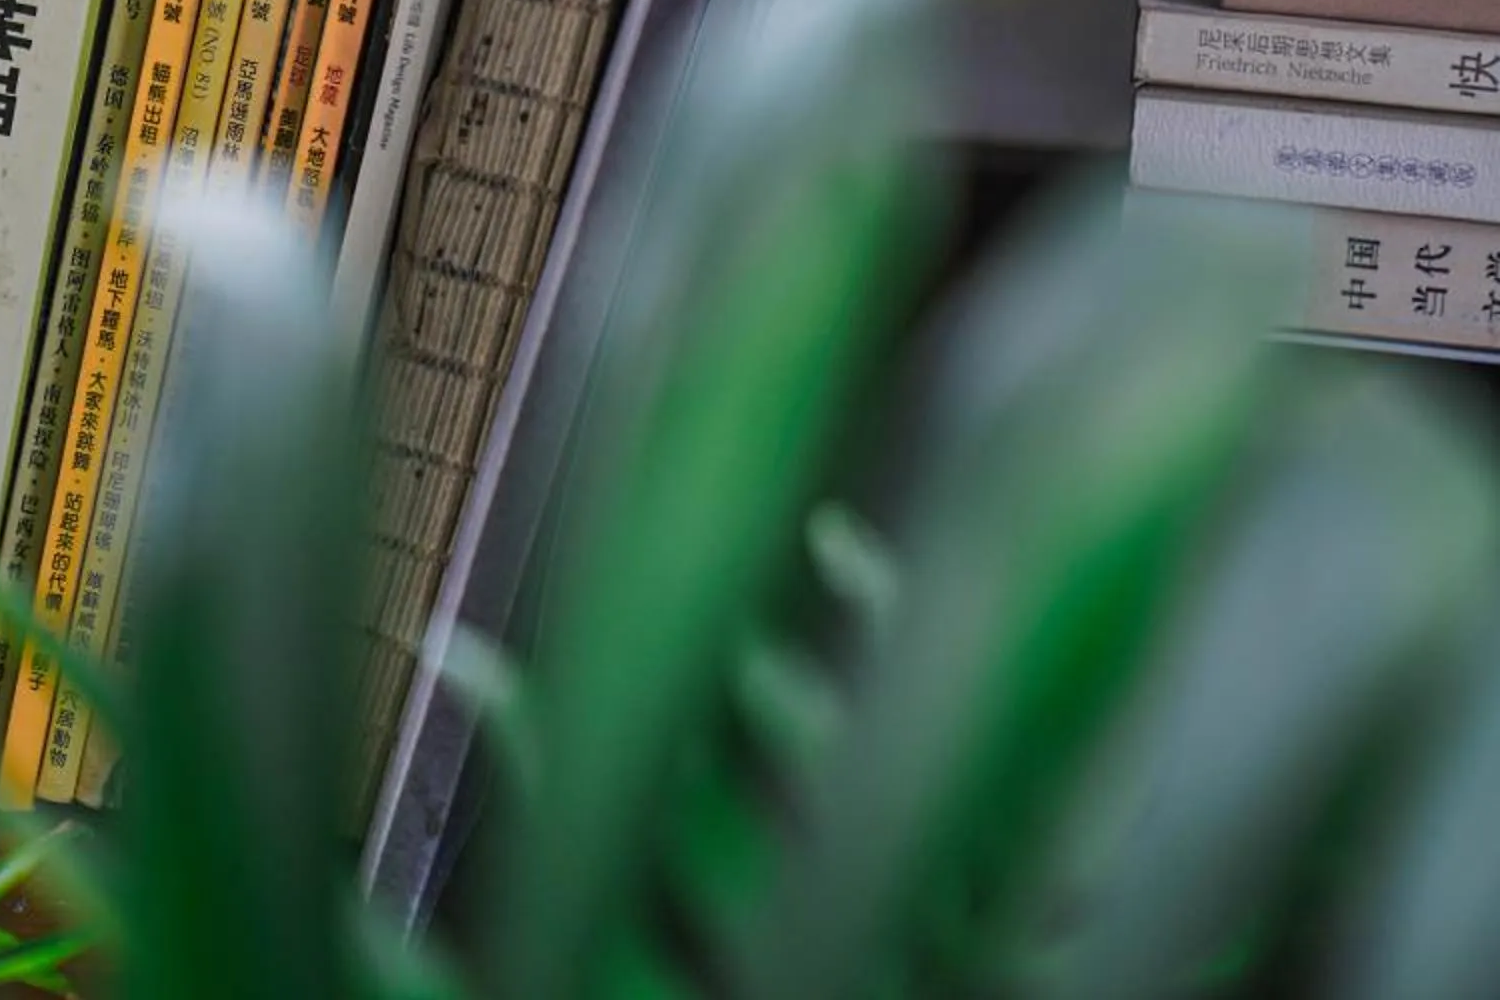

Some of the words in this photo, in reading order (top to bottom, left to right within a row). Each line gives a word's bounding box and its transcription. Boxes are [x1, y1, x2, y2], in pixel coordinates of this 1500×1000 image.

[1196, 53, 1278, 79] Friedrich
[1287, 60, 1374, 86] Nietzsche
[1198, 27, 1393, 68] 尼采后期思想文集
[1340, 237, 1381, 310] 中国
[1411, 244, 1453, 317] 当代
